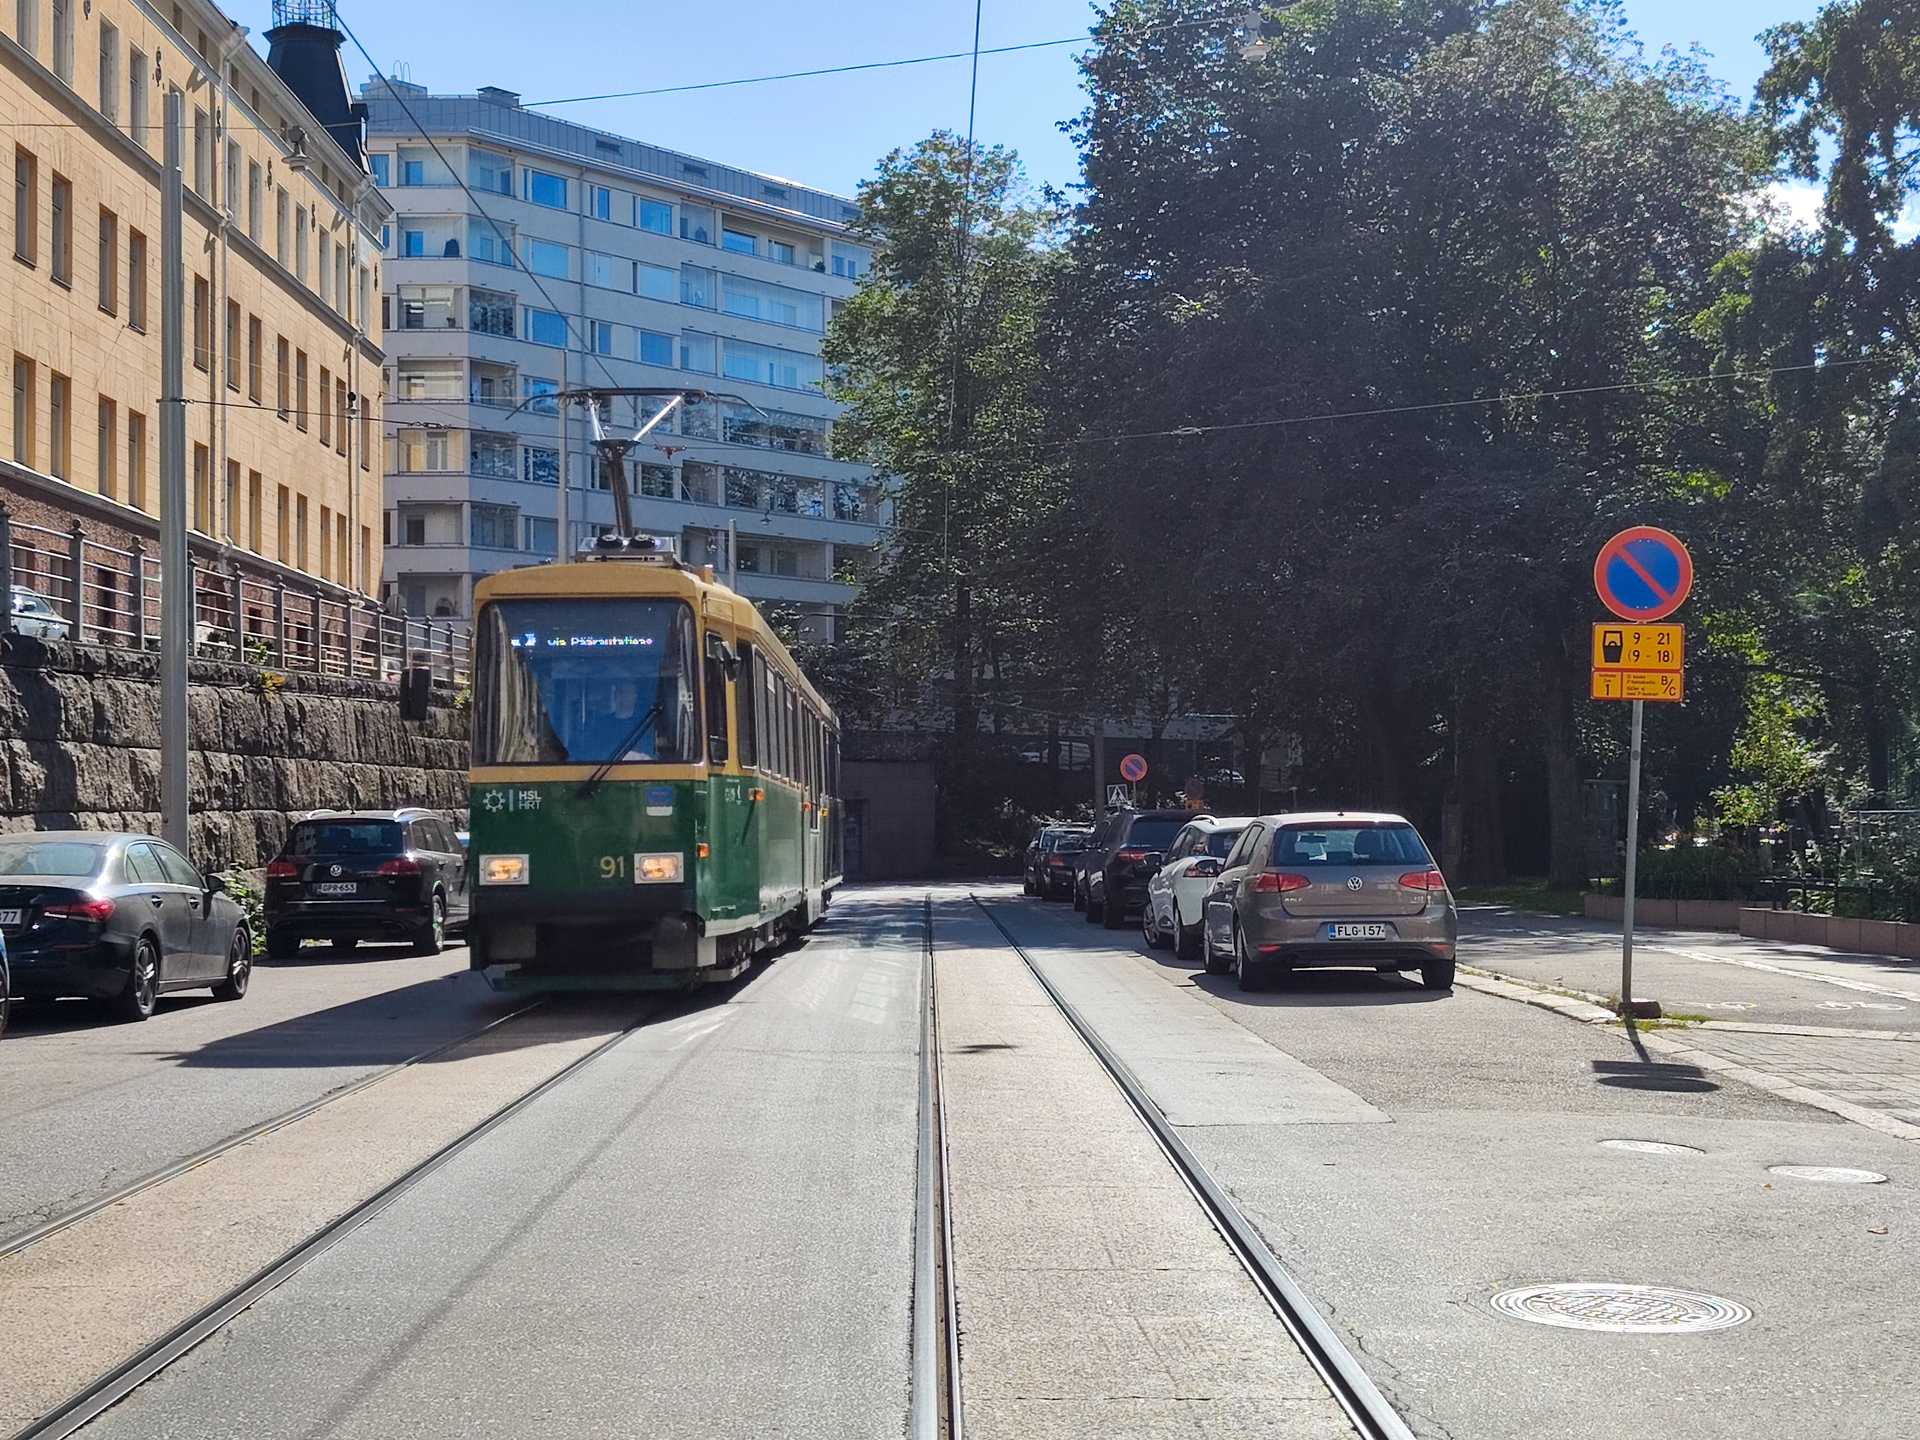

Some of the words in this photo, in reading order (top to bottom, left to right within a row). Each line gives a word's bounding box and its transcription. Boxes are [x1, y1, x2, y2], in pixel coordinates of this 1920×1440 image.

[1633, 632, 1641, 645] 9
[1657, 632, 1670, 645] 21
[1628, 649, 1640, 662] (9
[1657, 650, 1674, 663] 18)
[1605, 683, 1610, 696] 1
[518, 790, 542, 800] HSL
[518, 800, 542, 810] HRT
[600, 855, 625, 878] 91
[1337, 925, 1382, 936] FLG-157
